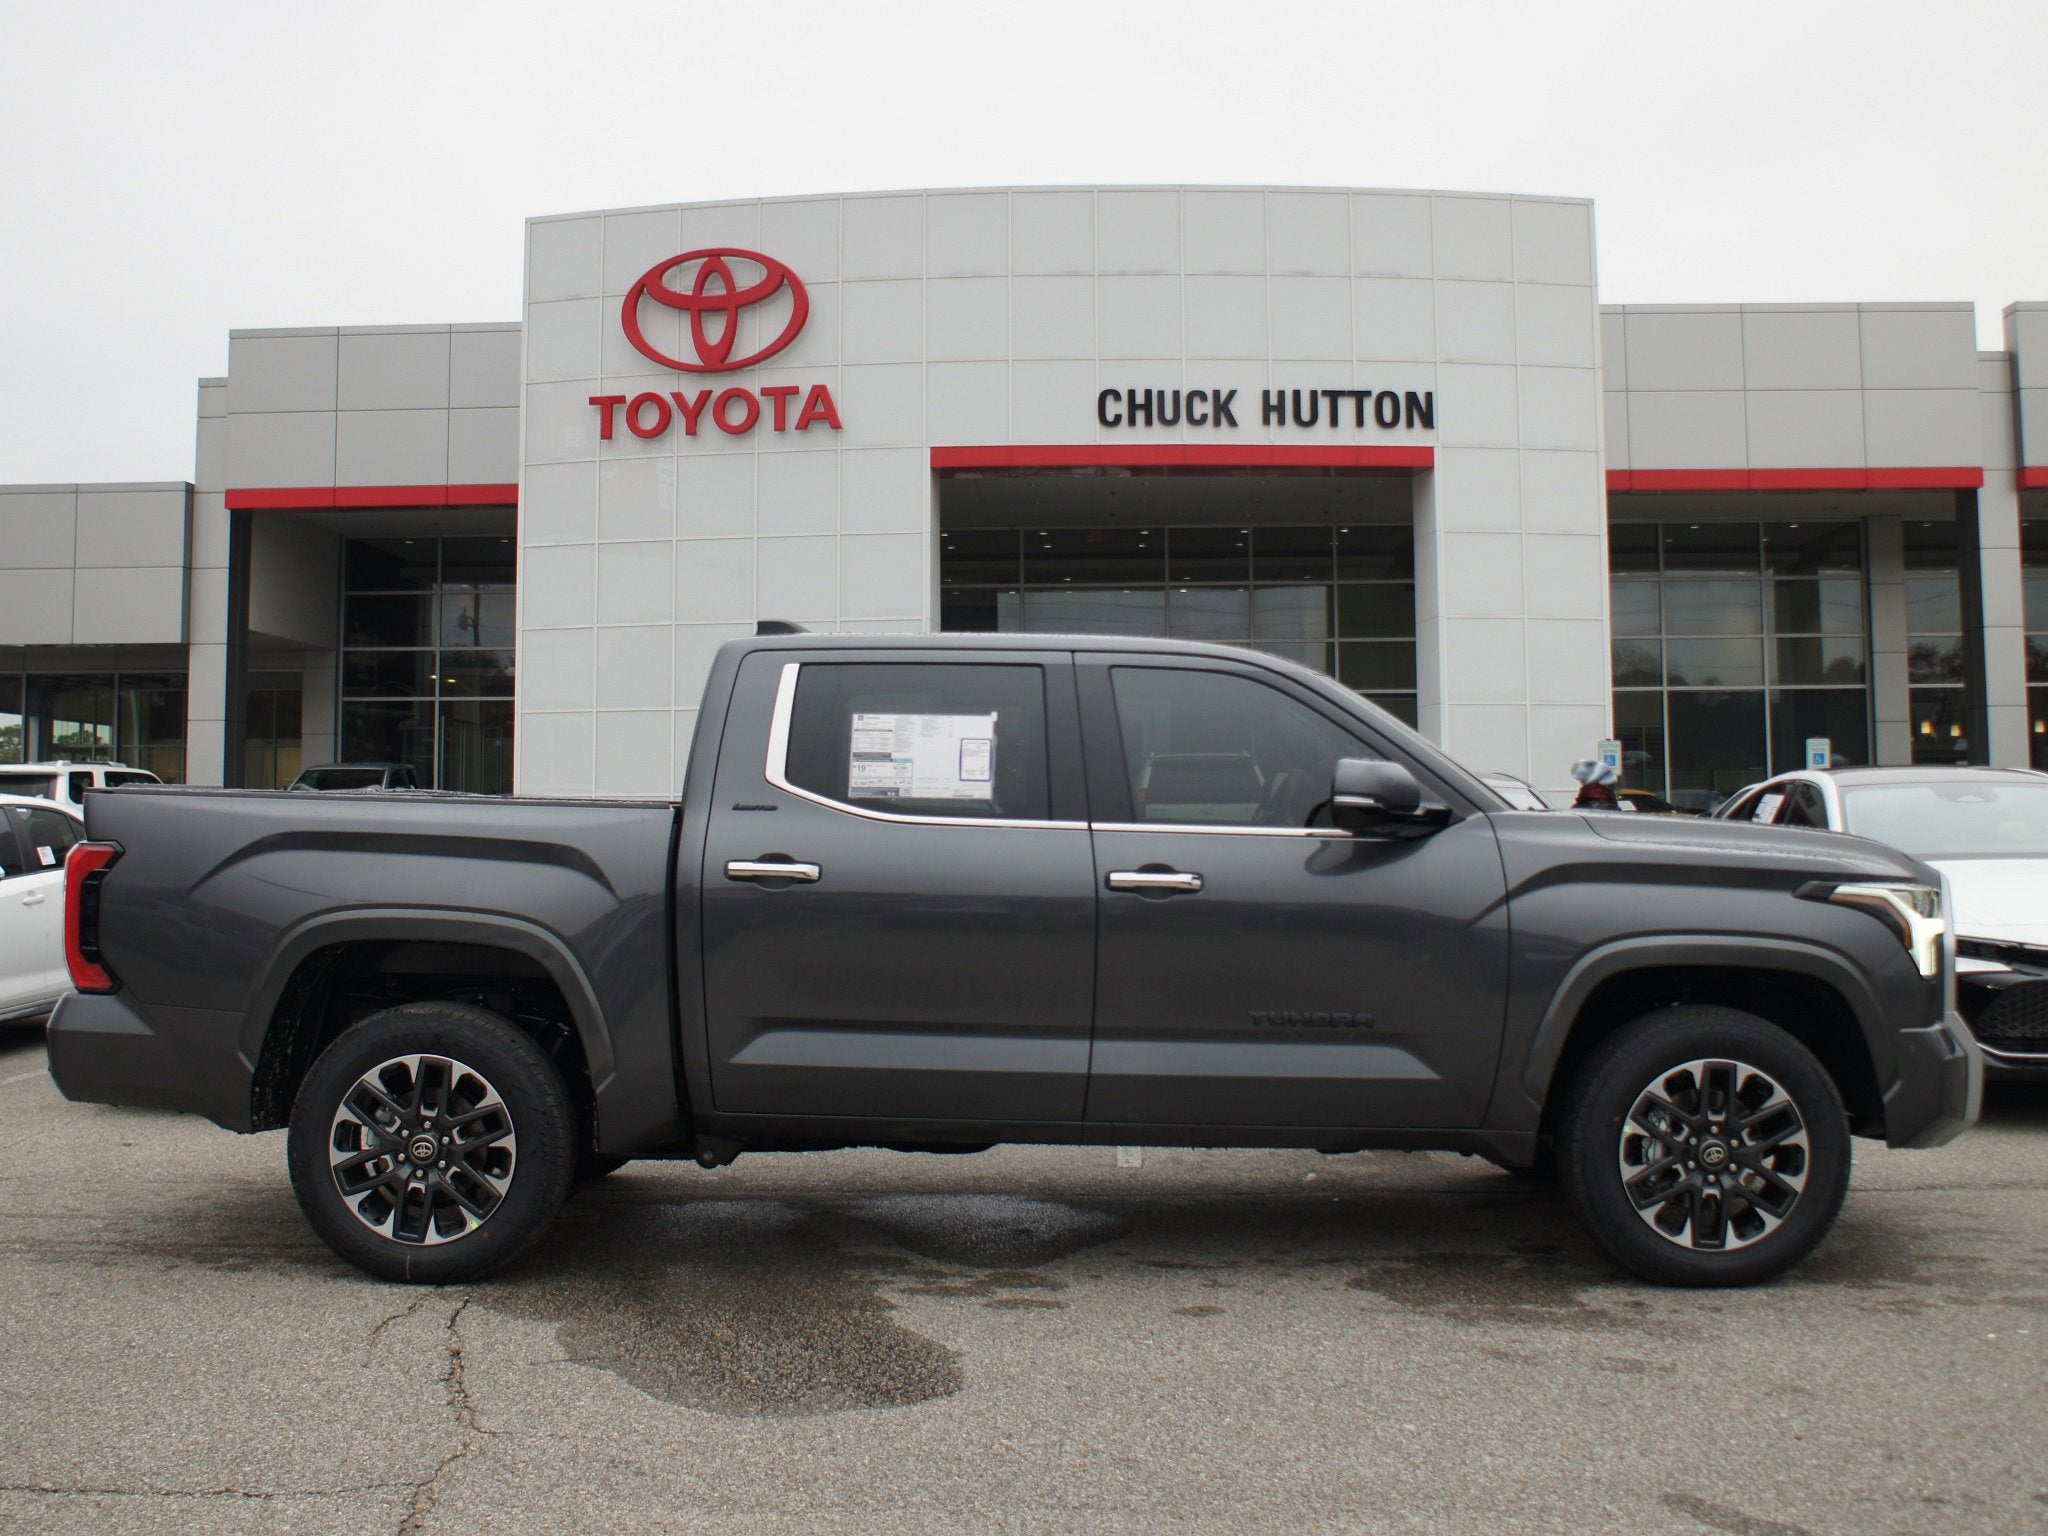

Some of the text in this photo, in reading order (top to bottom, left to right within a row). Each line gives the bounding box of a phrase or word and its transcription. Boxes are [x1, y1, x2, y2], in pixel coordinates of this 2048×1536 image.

[589, 384, 843, 440] TOYOTA
[1098, 389, 1434, 429] CHUCK HUTTON
[1248, 1010, 1375, 1029] TUNDRA
